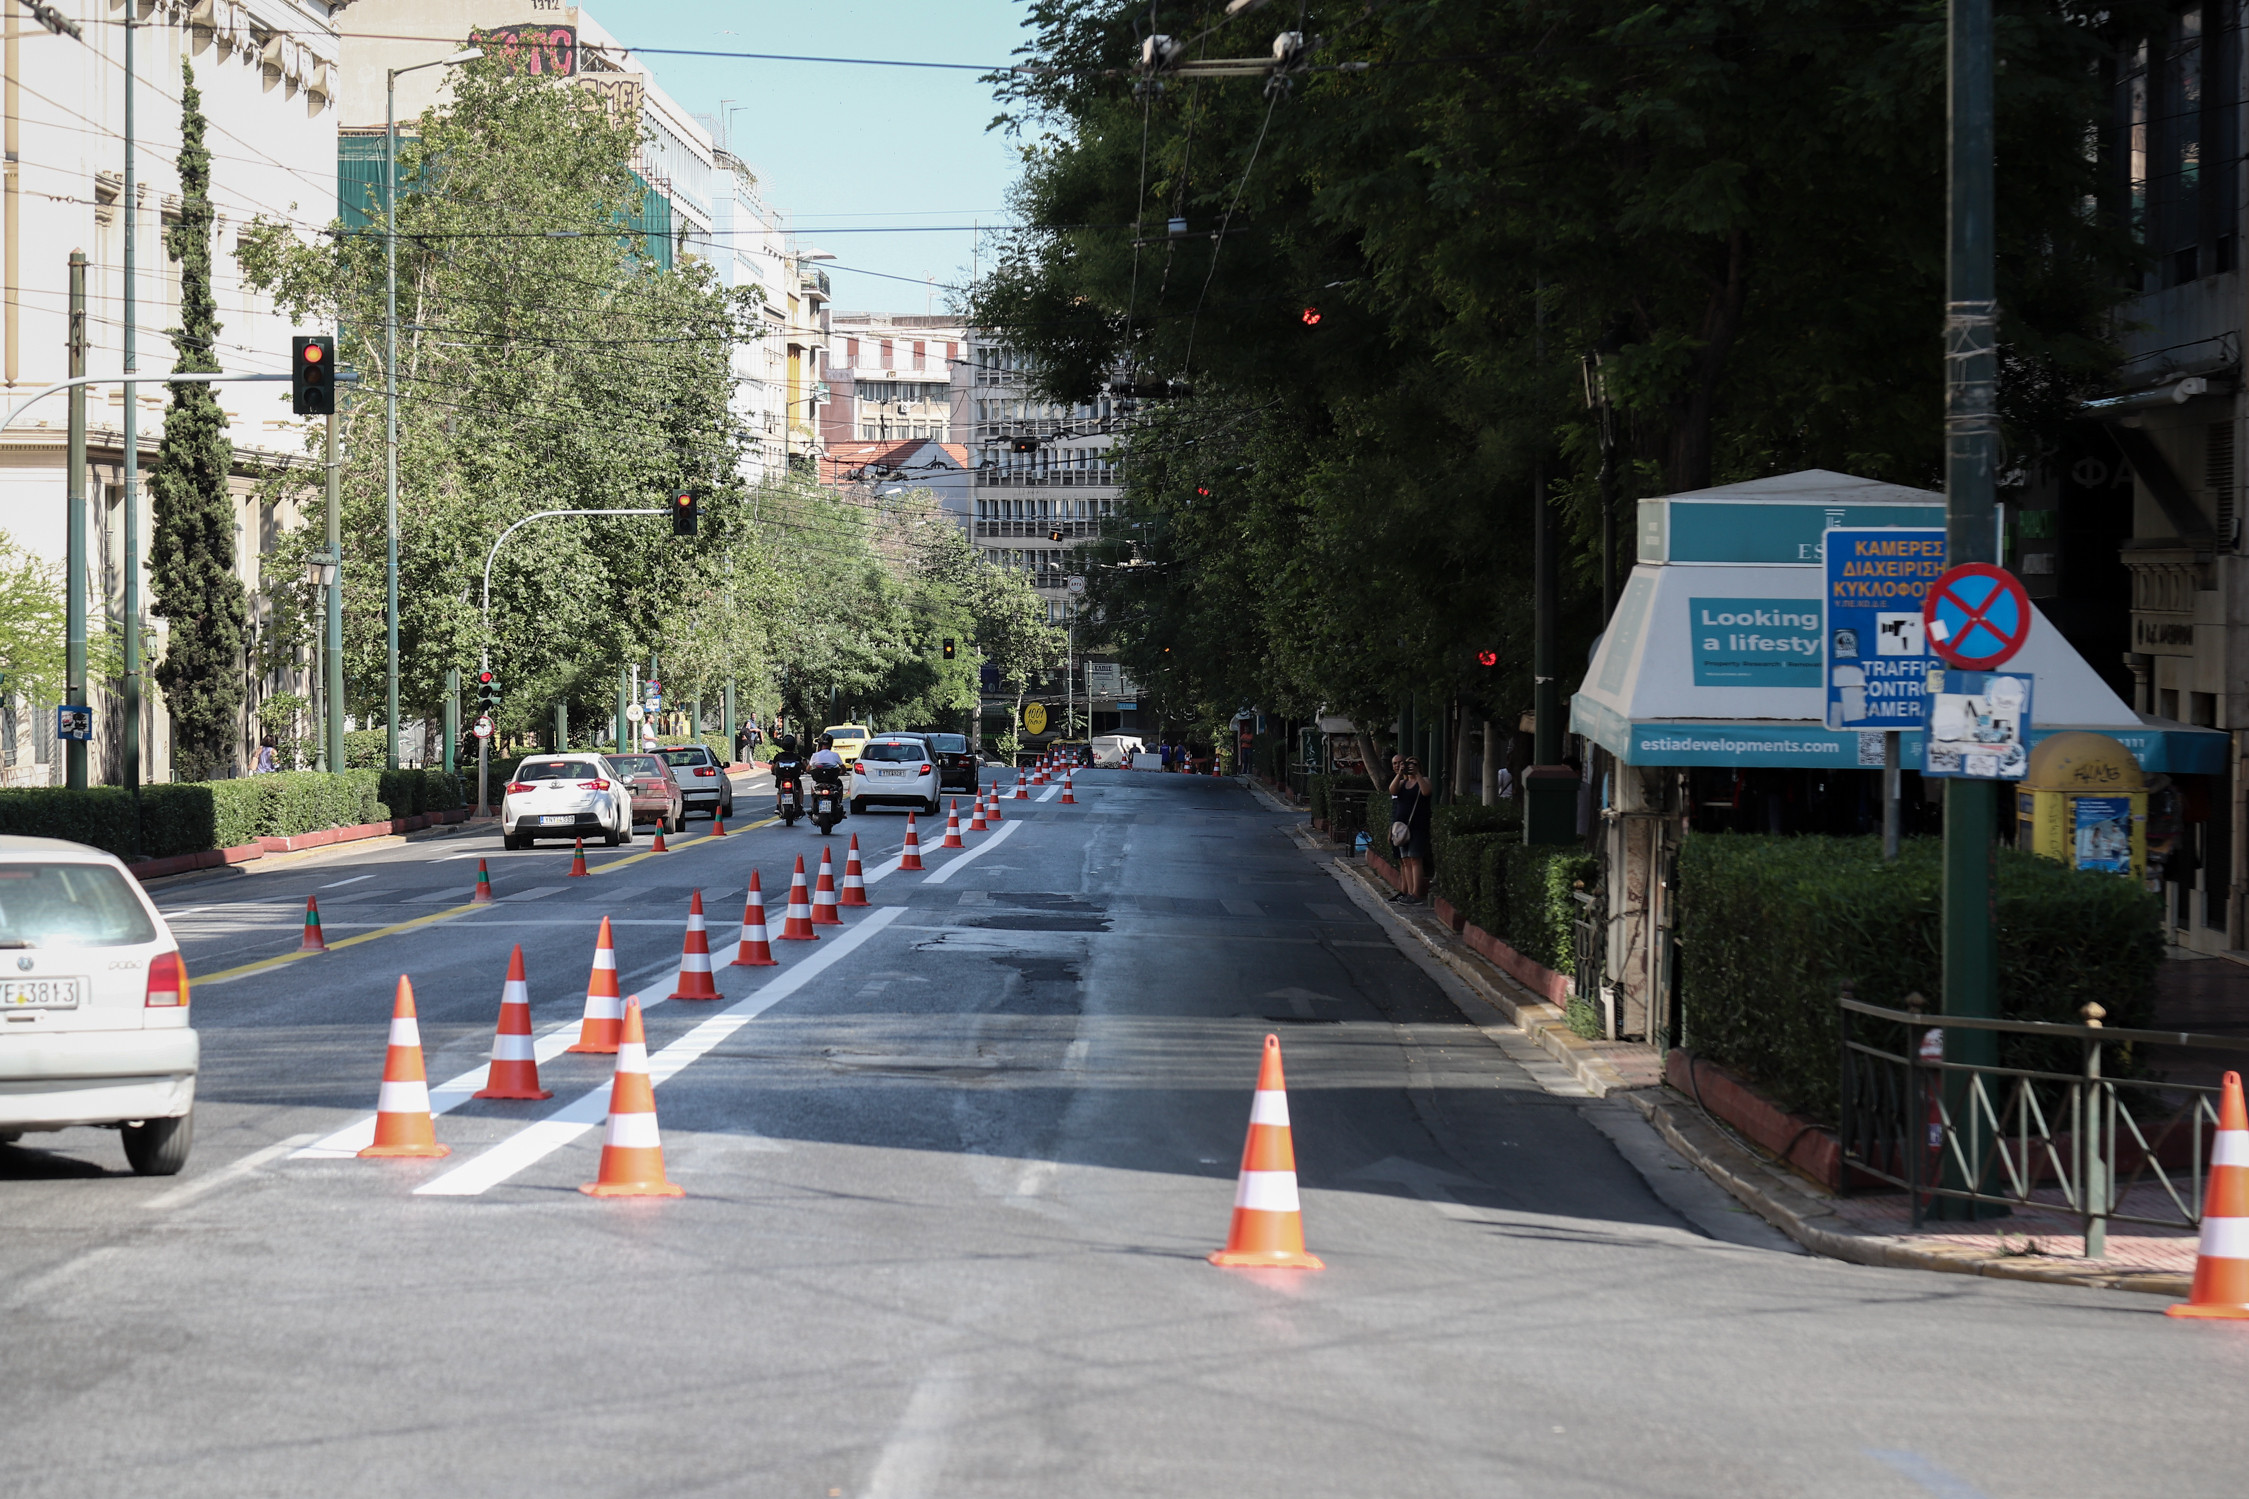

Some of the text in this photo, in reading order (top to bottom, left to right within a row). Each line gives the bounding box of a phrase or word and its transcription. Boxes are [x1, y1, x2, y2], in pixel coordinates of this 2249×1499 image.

[1855, 541, 1944, 556] ΚΑΜΕΡΕΣ
[1702, 610, 1819, 630] Looking
[1703, 637, 1720, 651] a
[1028, 708, 1045, 718] 1001
[1641, 738, 1840, 755] estiadevelopments.com
